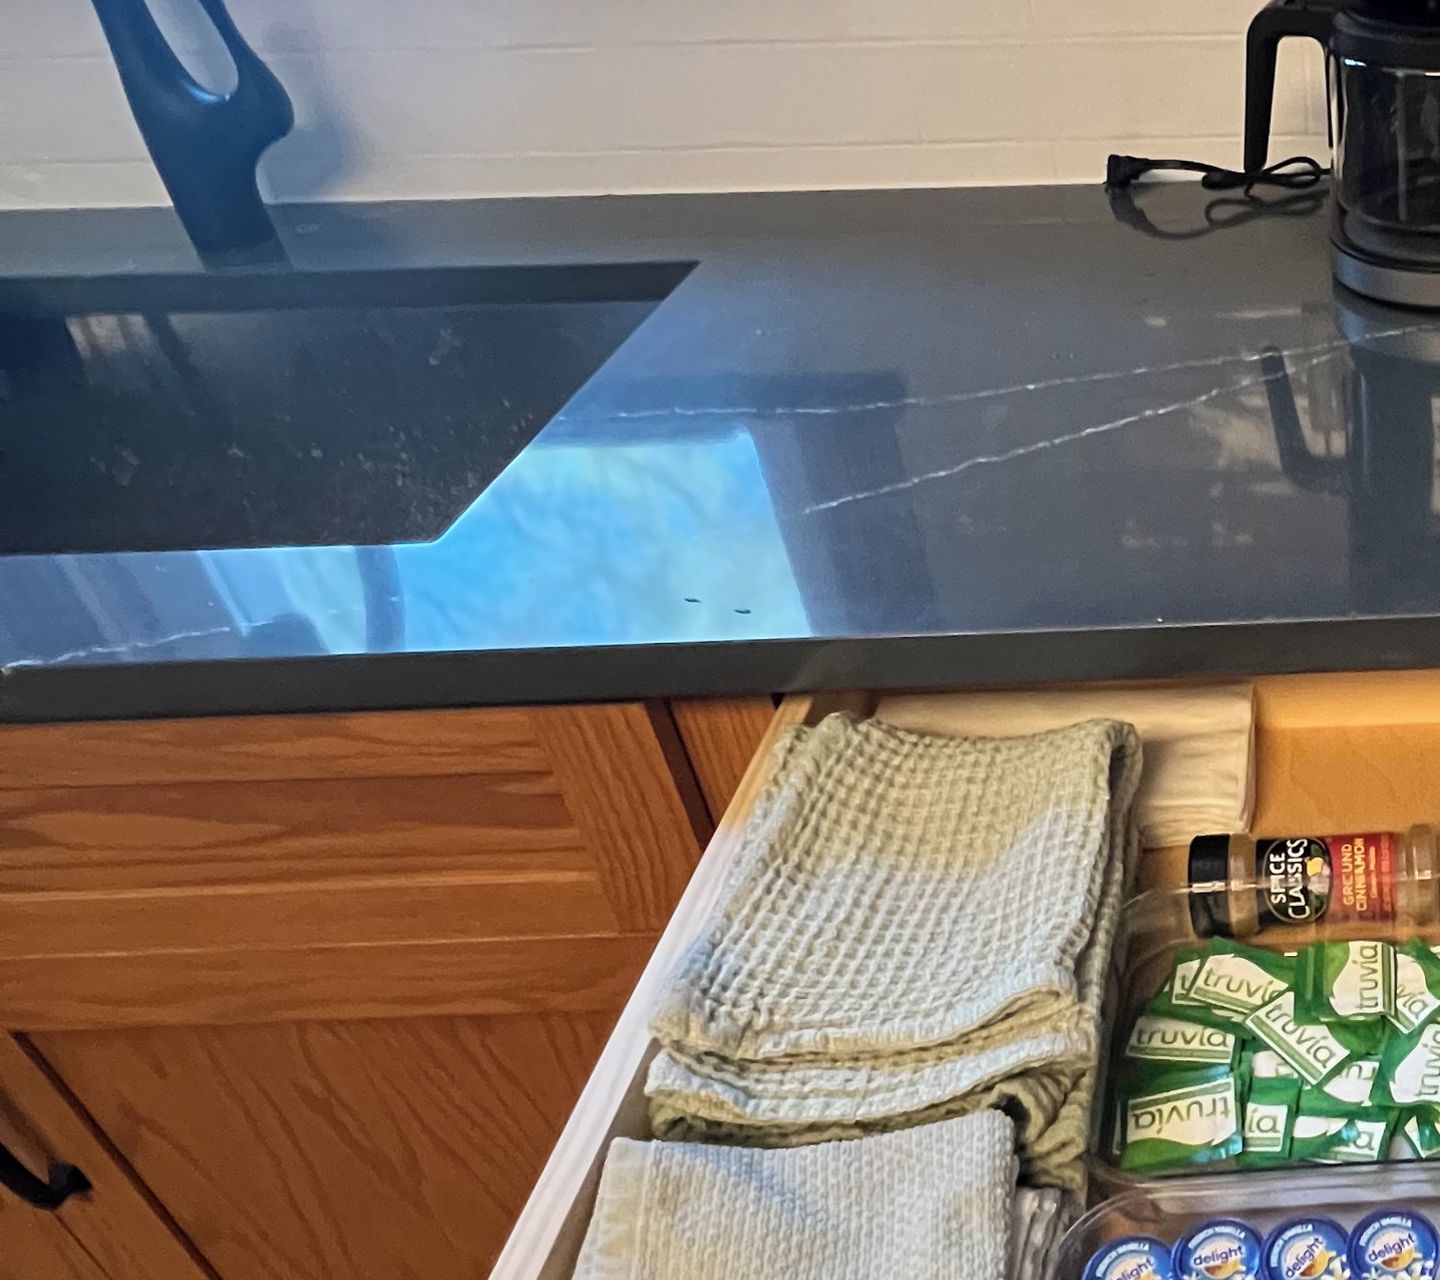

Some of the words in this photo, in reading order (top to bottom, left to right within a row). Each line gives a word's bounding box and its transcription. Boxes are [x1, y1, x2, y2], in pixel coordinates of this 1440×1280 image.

[1193, 1245, 1244, 1266] delight
[1285, 1237, 1325, 1279] delight
[1368, 1233, 1415, 1262] delight
